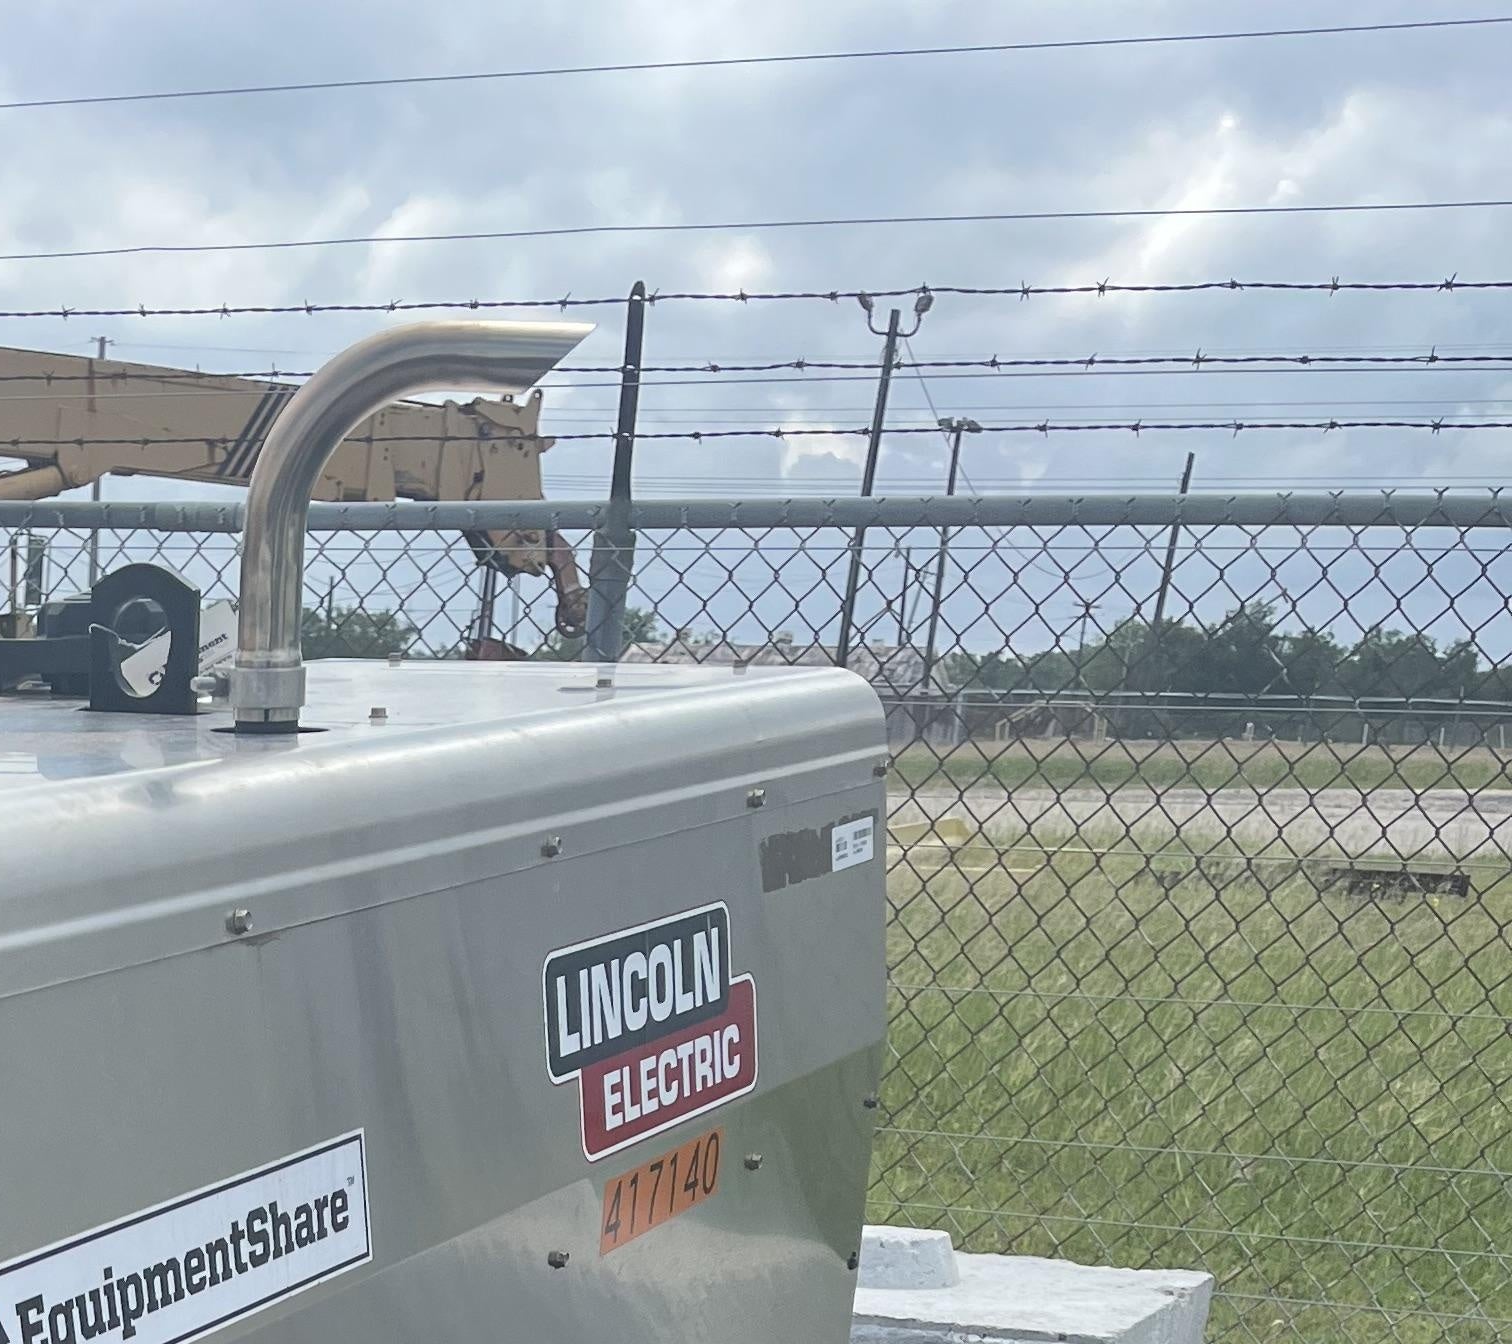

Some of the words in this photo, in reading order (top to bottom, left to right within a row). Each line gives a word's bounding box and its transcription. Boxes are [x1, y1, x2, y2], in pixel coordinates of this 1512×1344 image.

[556, 926, 721, 1058] LINCOLN
[603, 1023, 741, 1132] ELECTRIC
[604, 1132, 719, 1243] 417140
